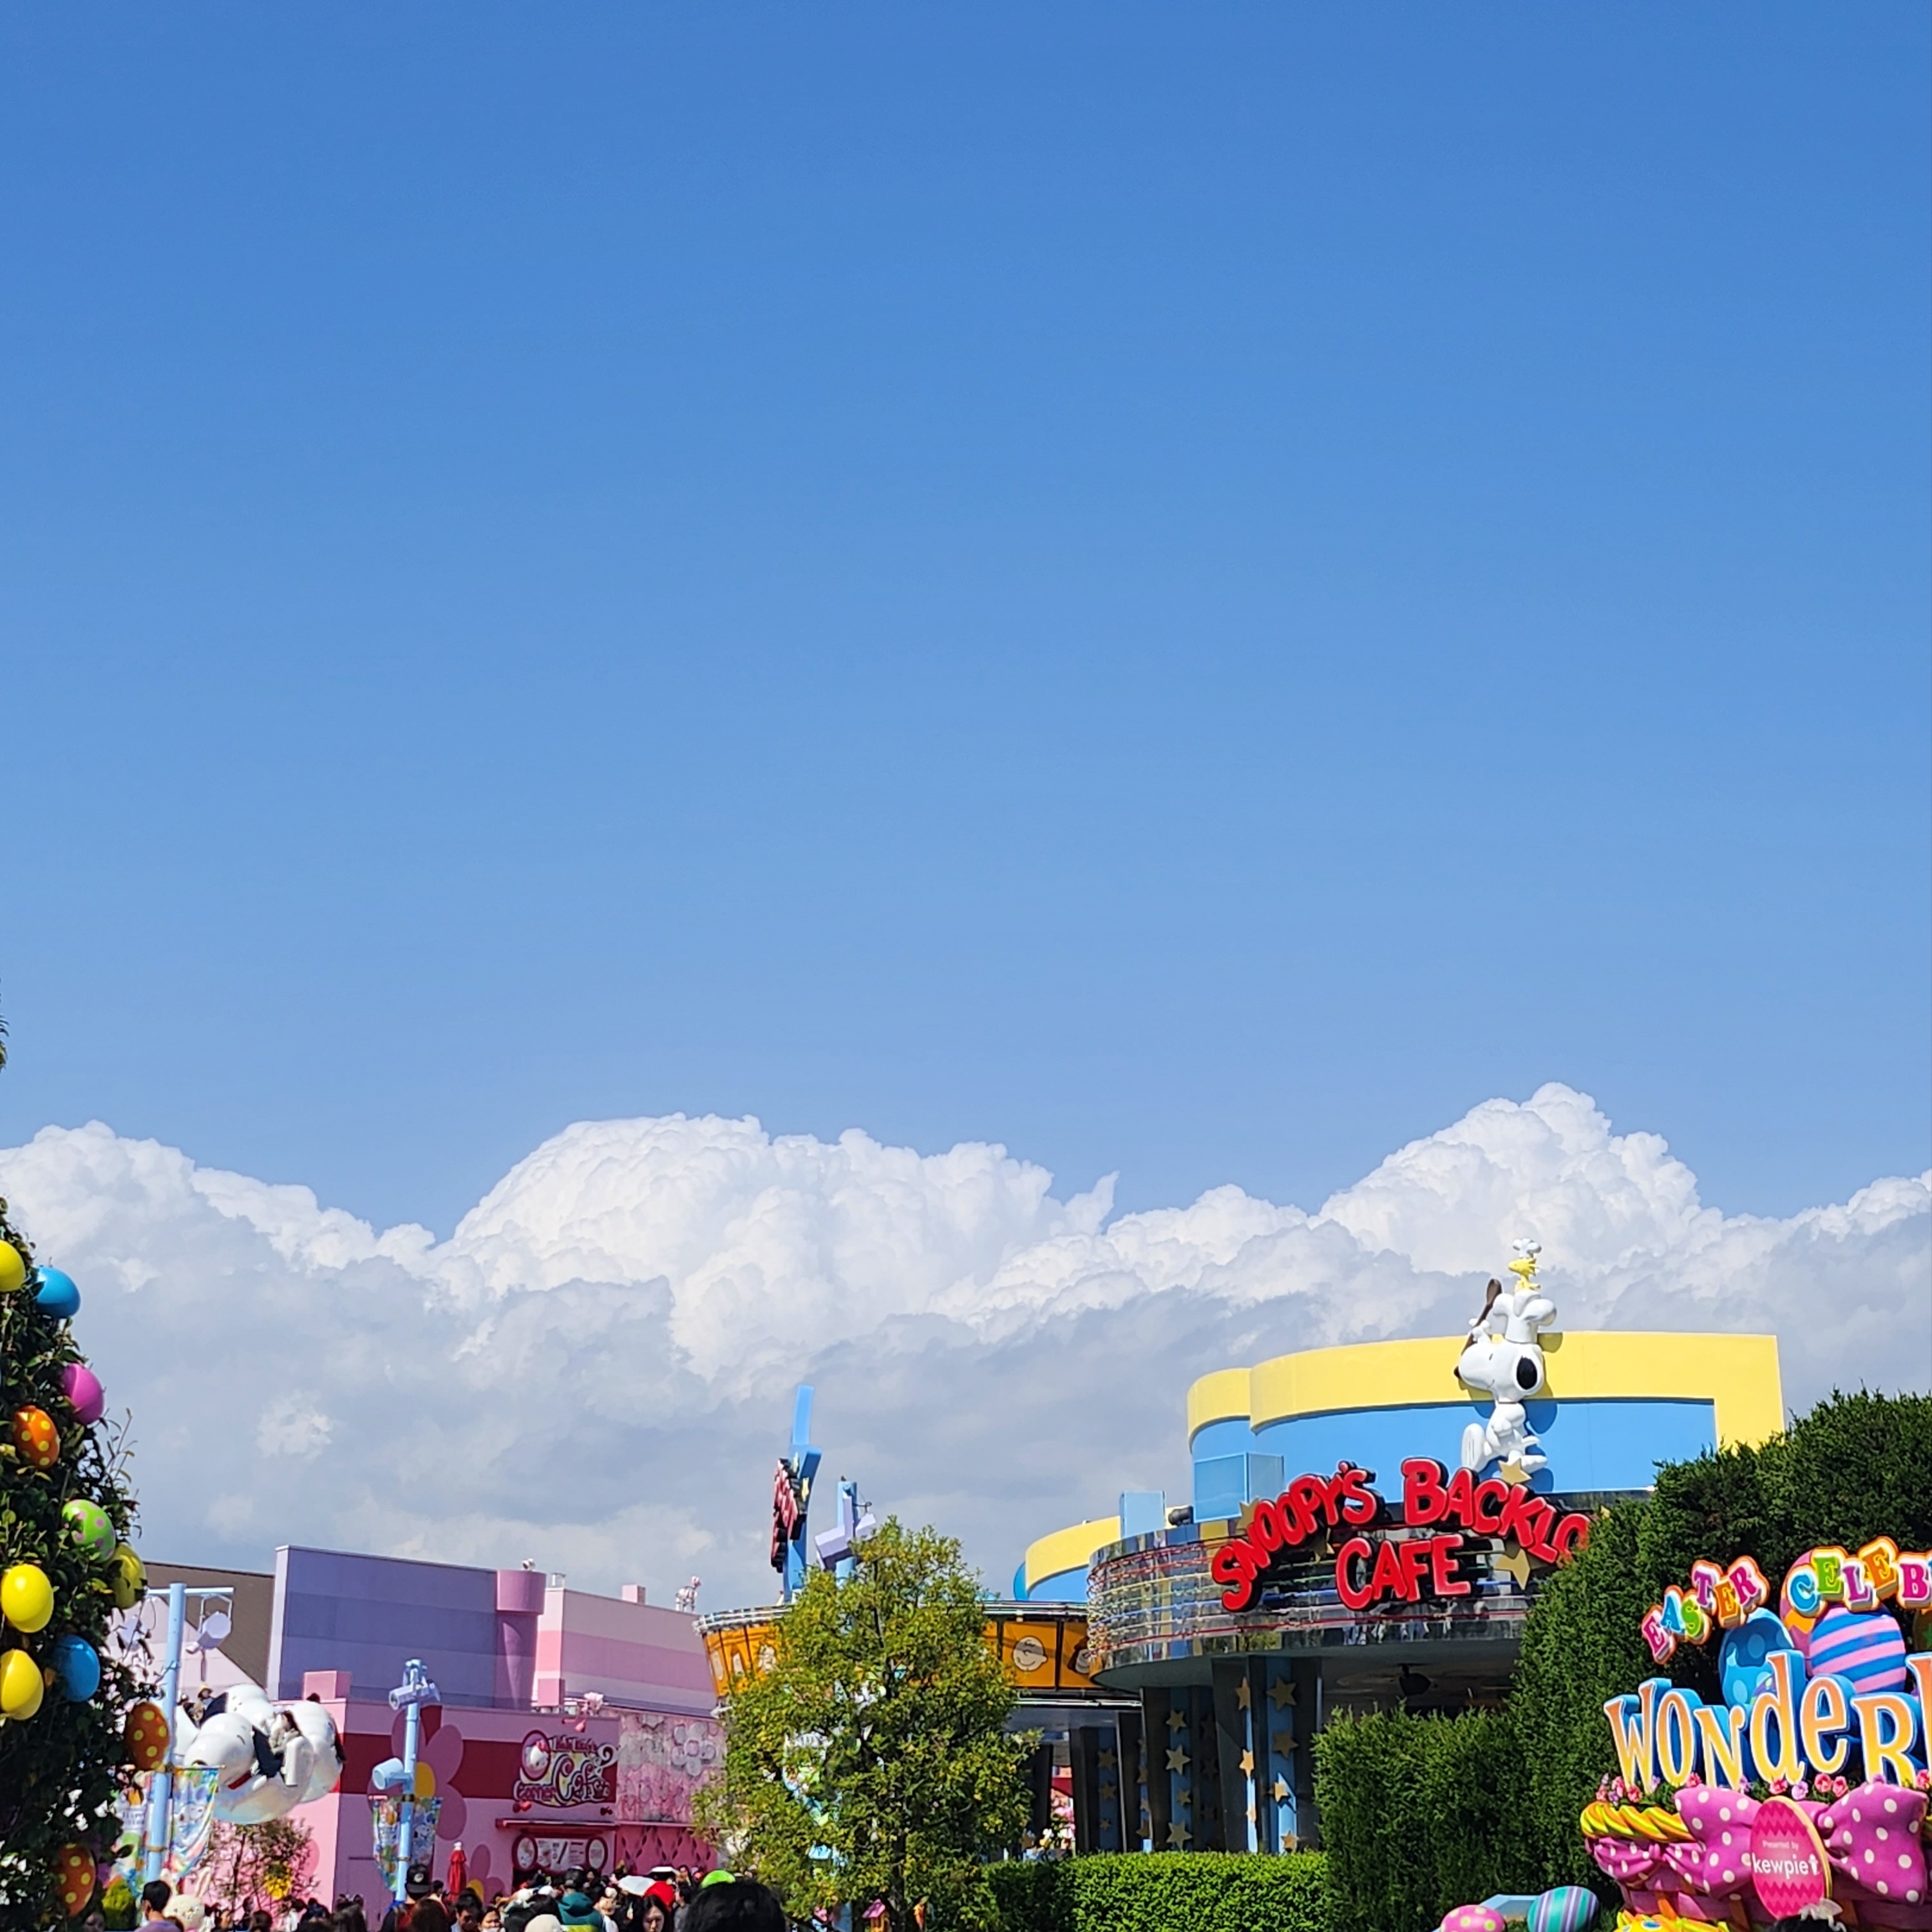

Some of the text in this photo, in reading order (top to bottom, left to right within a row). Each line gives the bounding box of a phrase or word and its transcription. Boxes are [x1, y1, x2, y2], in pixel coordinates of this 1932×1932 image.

[1211, 1461, 1379, 1610] SNOOPY'S
[1335, 1534, 1472, 1609] CAFE
[1642, 1538, 1932, 1662] EASTER CELEB
[1752, 1852, 1809, 1880] kewpie
